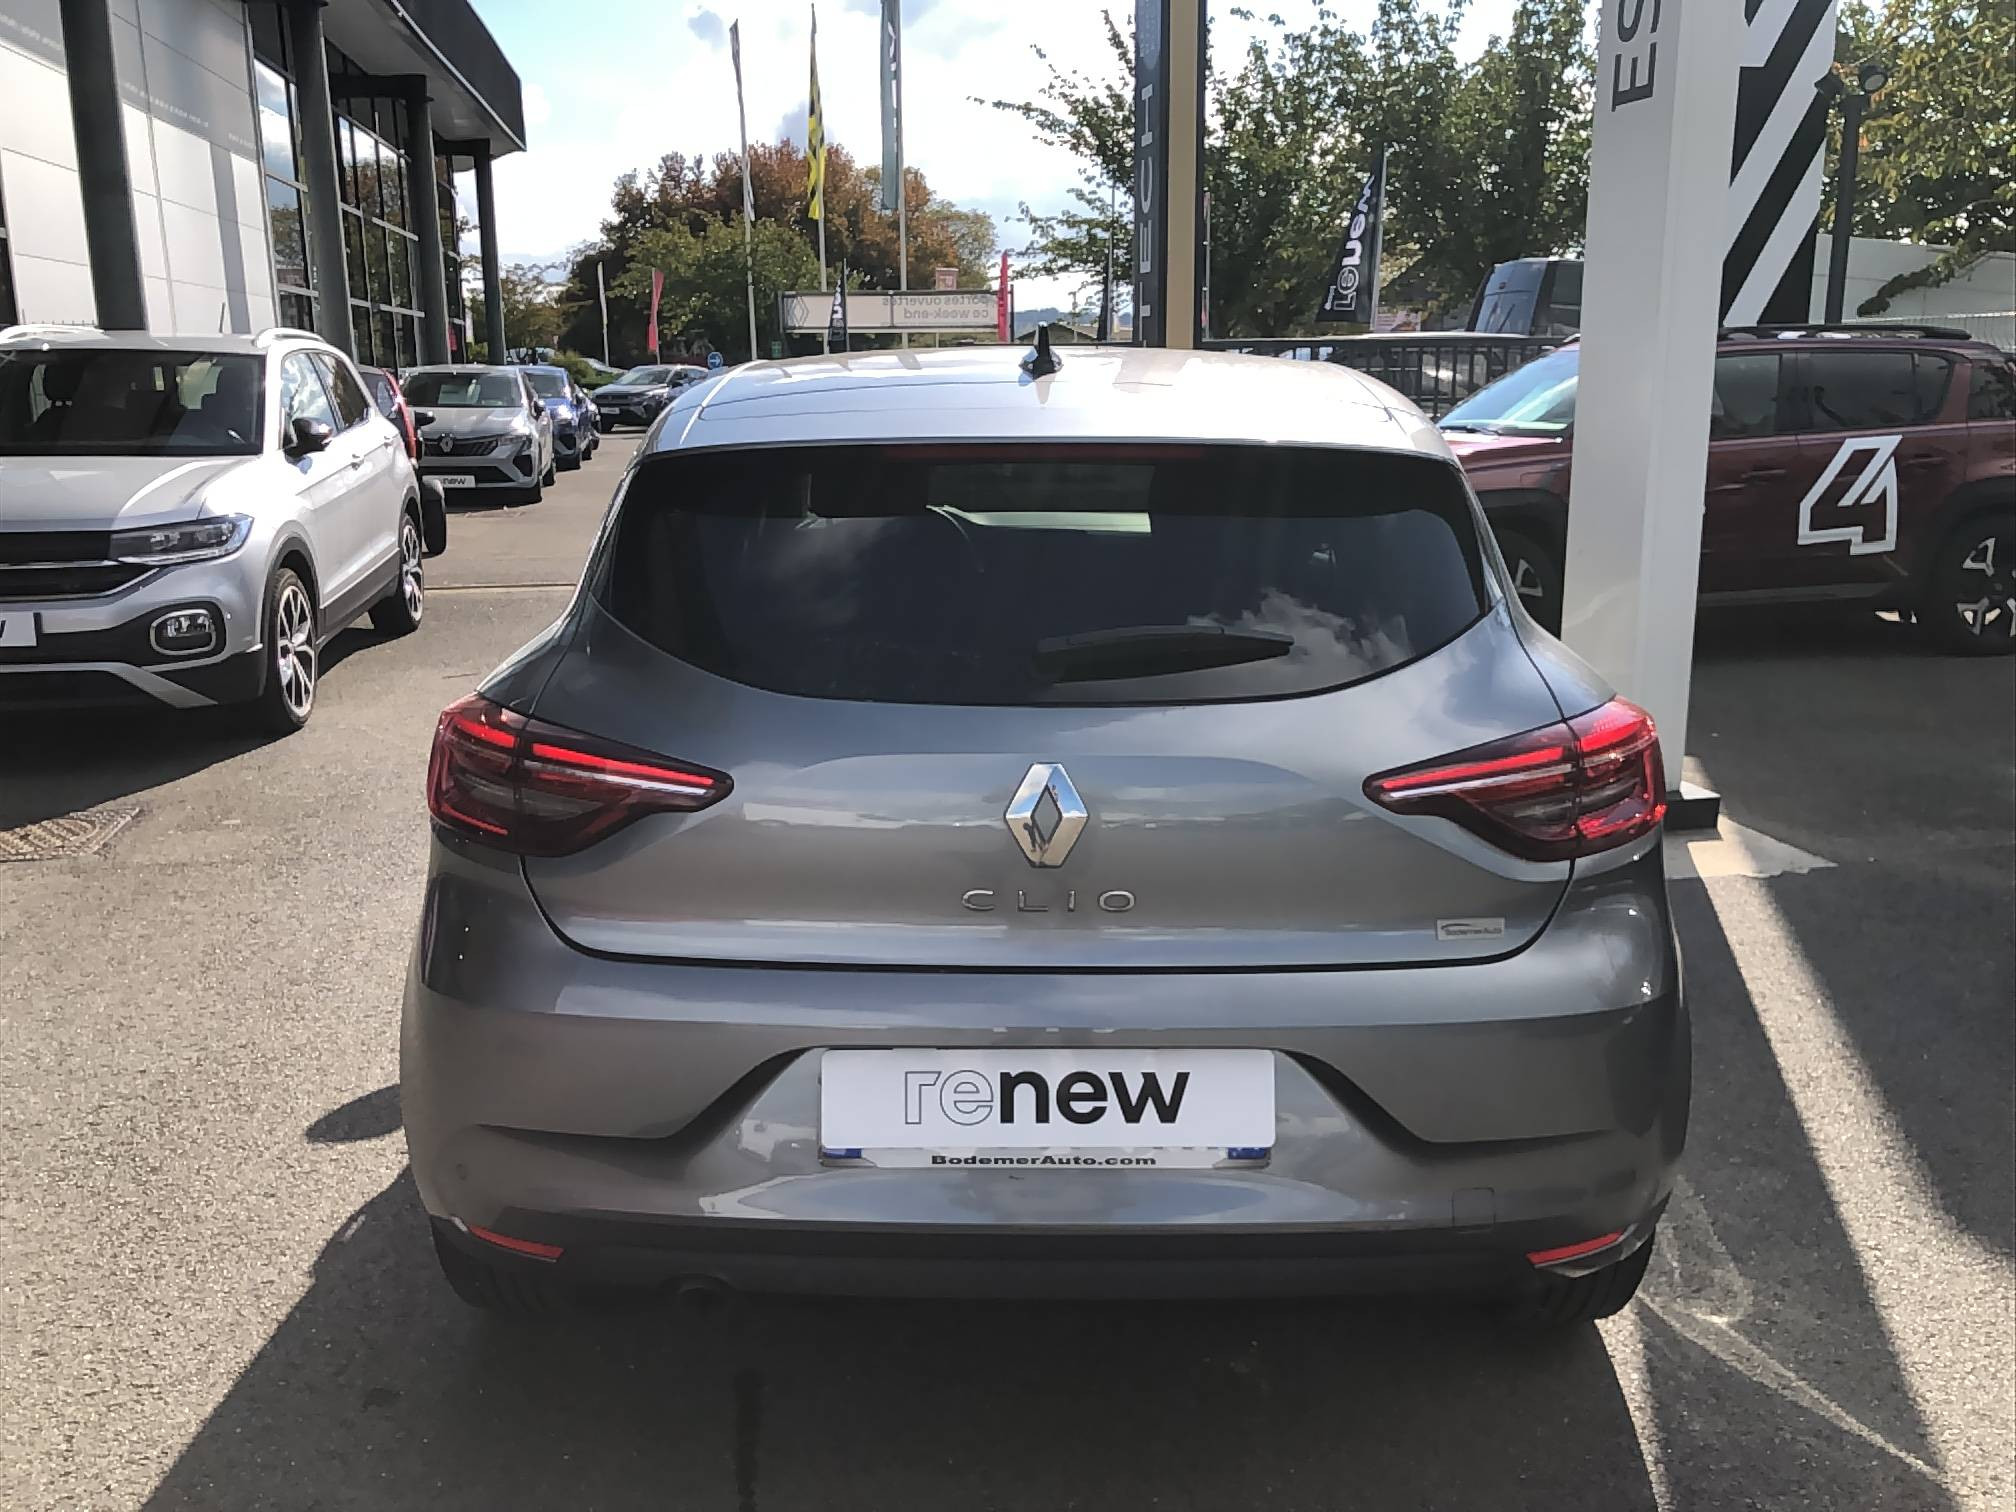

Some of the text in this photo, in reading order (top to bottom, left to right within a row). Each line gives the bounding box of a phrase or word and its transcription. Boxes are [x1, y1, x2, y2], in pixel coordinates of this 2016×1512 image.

[962, 889, 1136, 912] CLIO
[905, 1070, 1190, 1126] renew
[932, 1156, 1156, 1166] BodemerAuto.com
